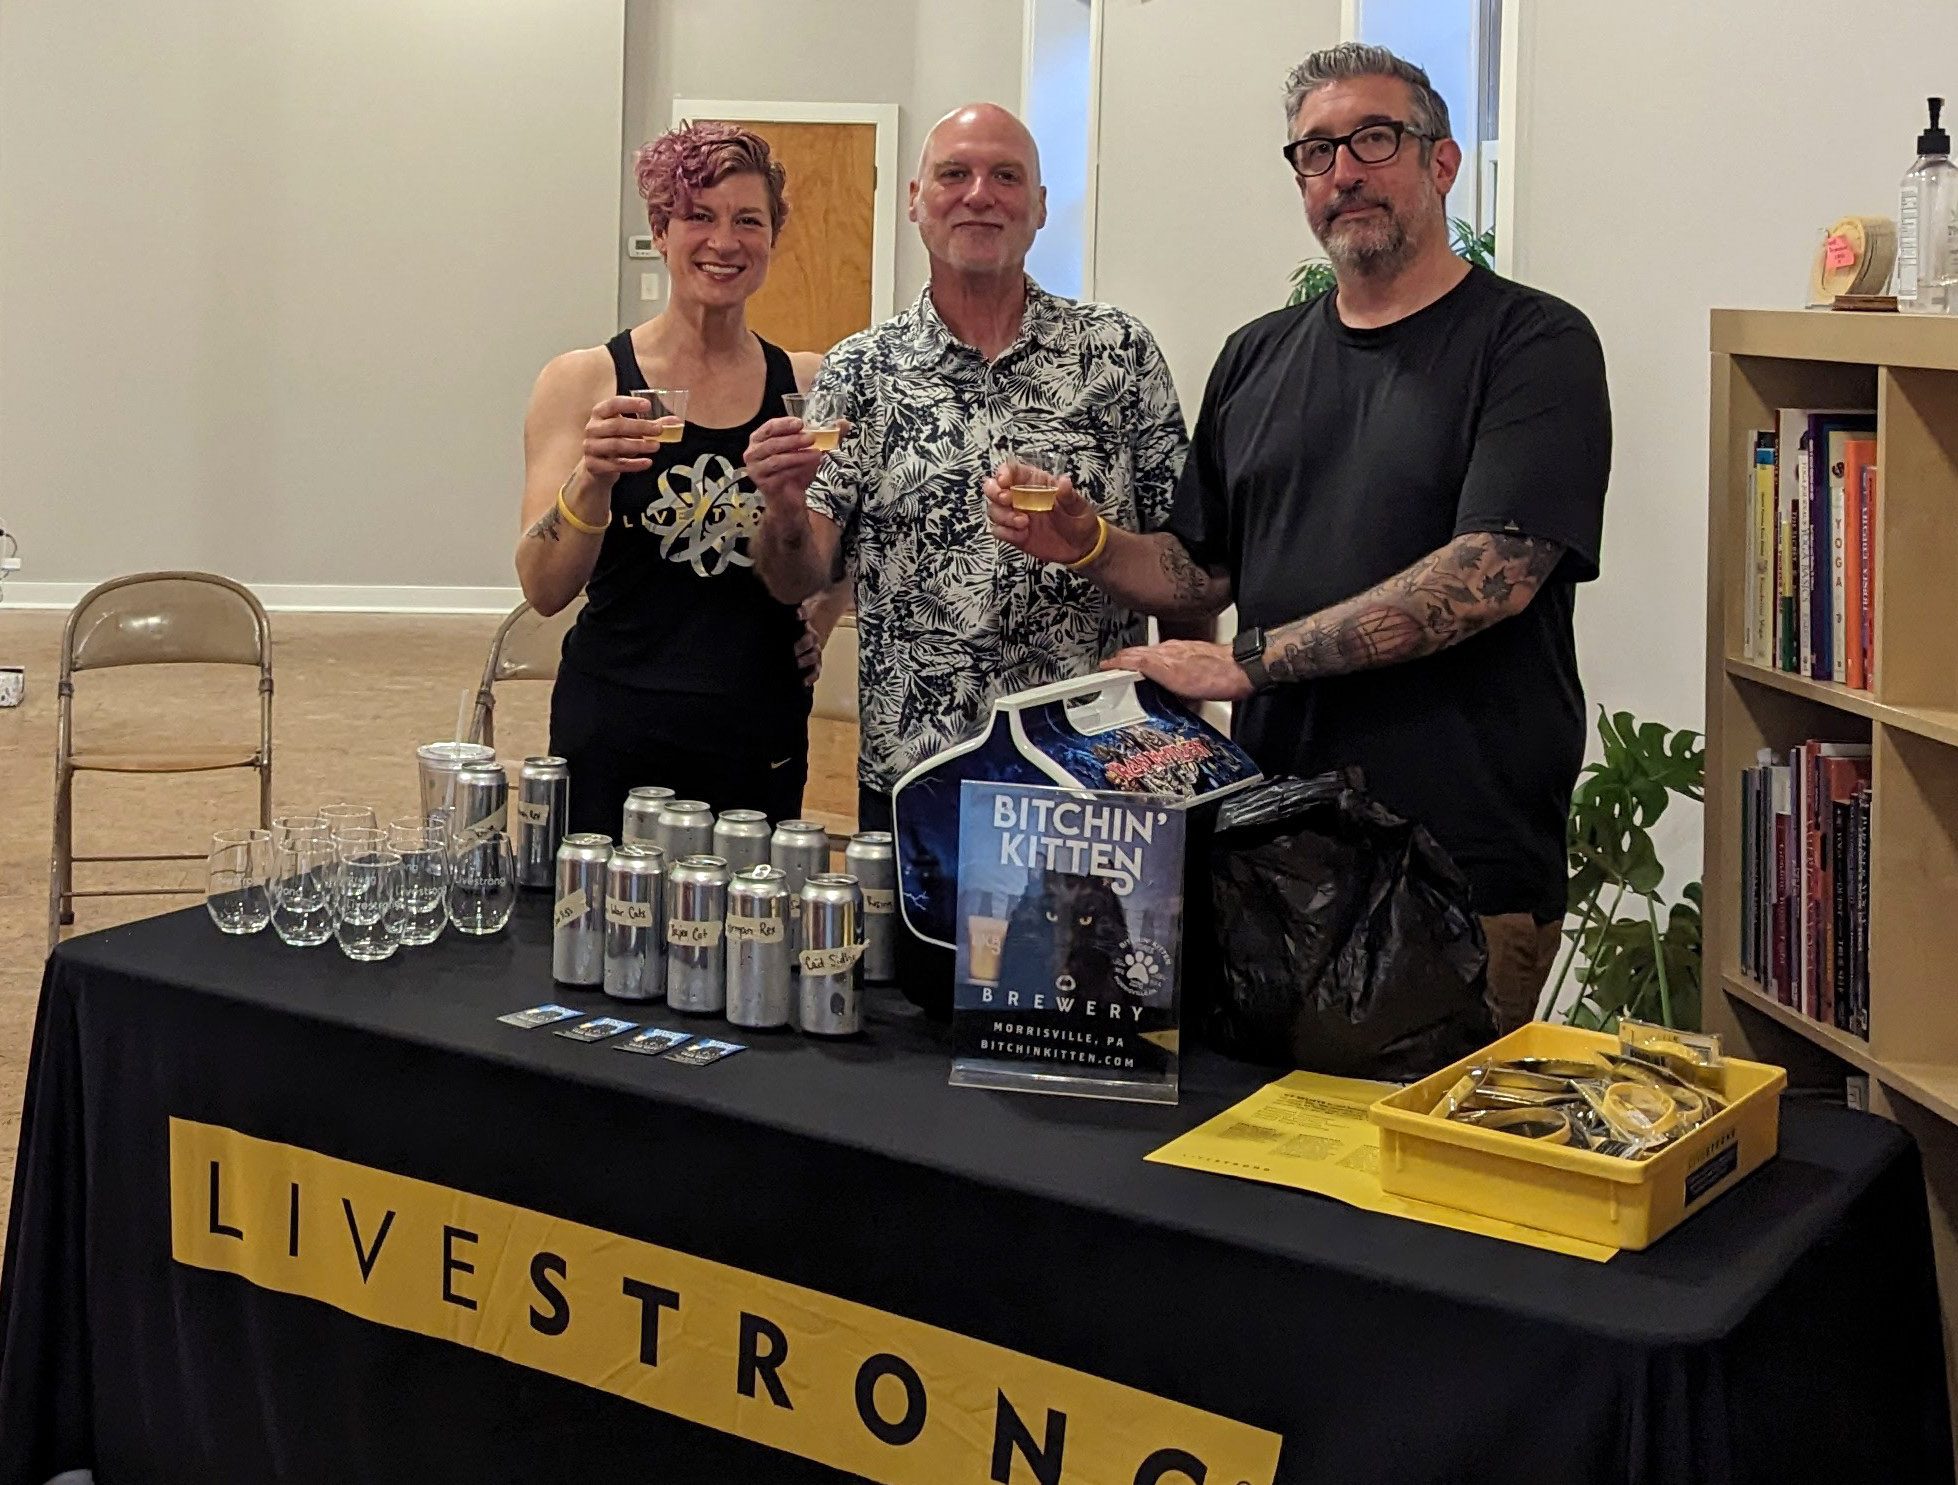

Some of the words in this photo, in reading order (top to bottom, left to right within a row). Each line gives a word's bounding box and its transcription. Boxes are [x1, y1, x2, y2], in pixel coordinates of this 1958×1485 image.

[1835, 517, 1843, 588] YOGA
[993, 794, 1168, 845] BITCHIN'
[1000, 832, 1143, 896] KITTEN
[982, 987, 1143, 1022] BREWERY
[980, 1039, 1134, 1068] BITCHINKITTEN.COM
[993, 1022, 1099, 1045] MORRISVILLE,
[1107, 1036, 1124, 1048] PA
